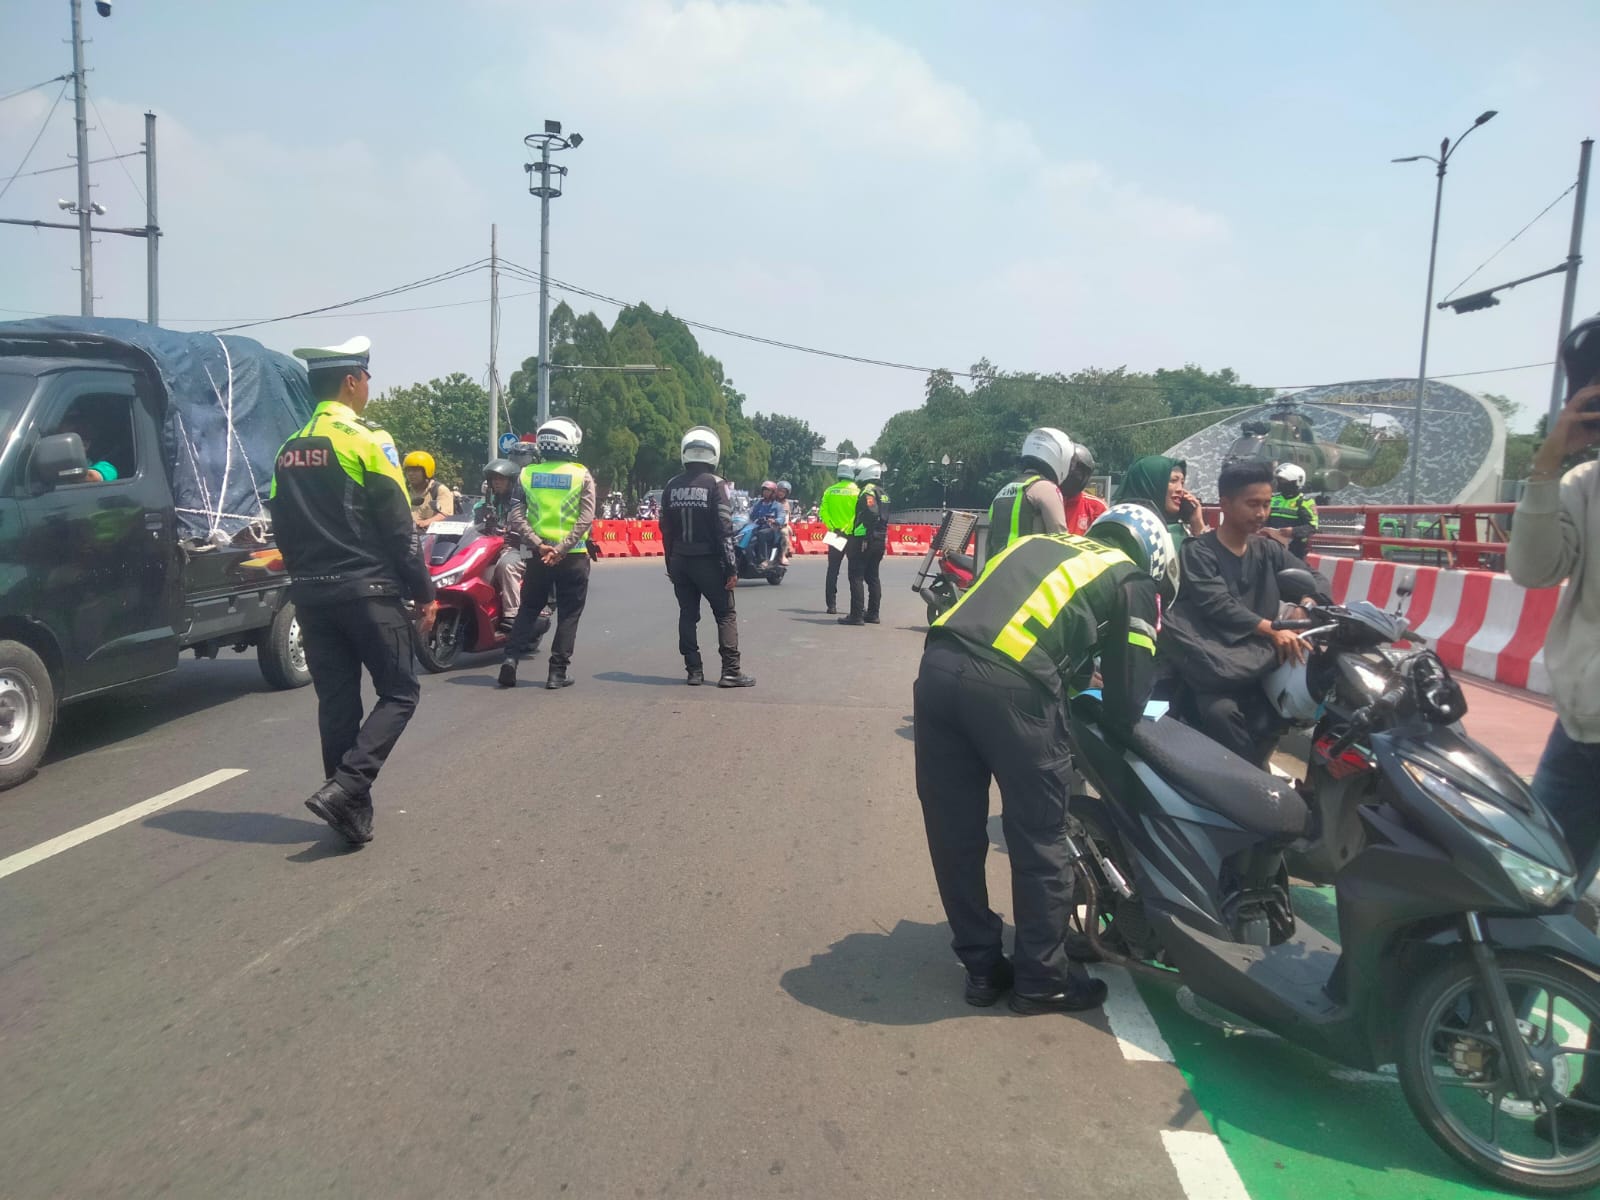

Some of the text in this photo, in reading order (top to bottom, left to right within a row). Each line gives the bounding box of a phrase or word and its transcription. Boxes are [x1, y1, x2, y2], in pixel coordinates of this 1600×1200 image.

[278, 449, 328, 470] POLISI
[533, 474, 569, 488] POLISI
[670, 487, 709, 502] POLISI
